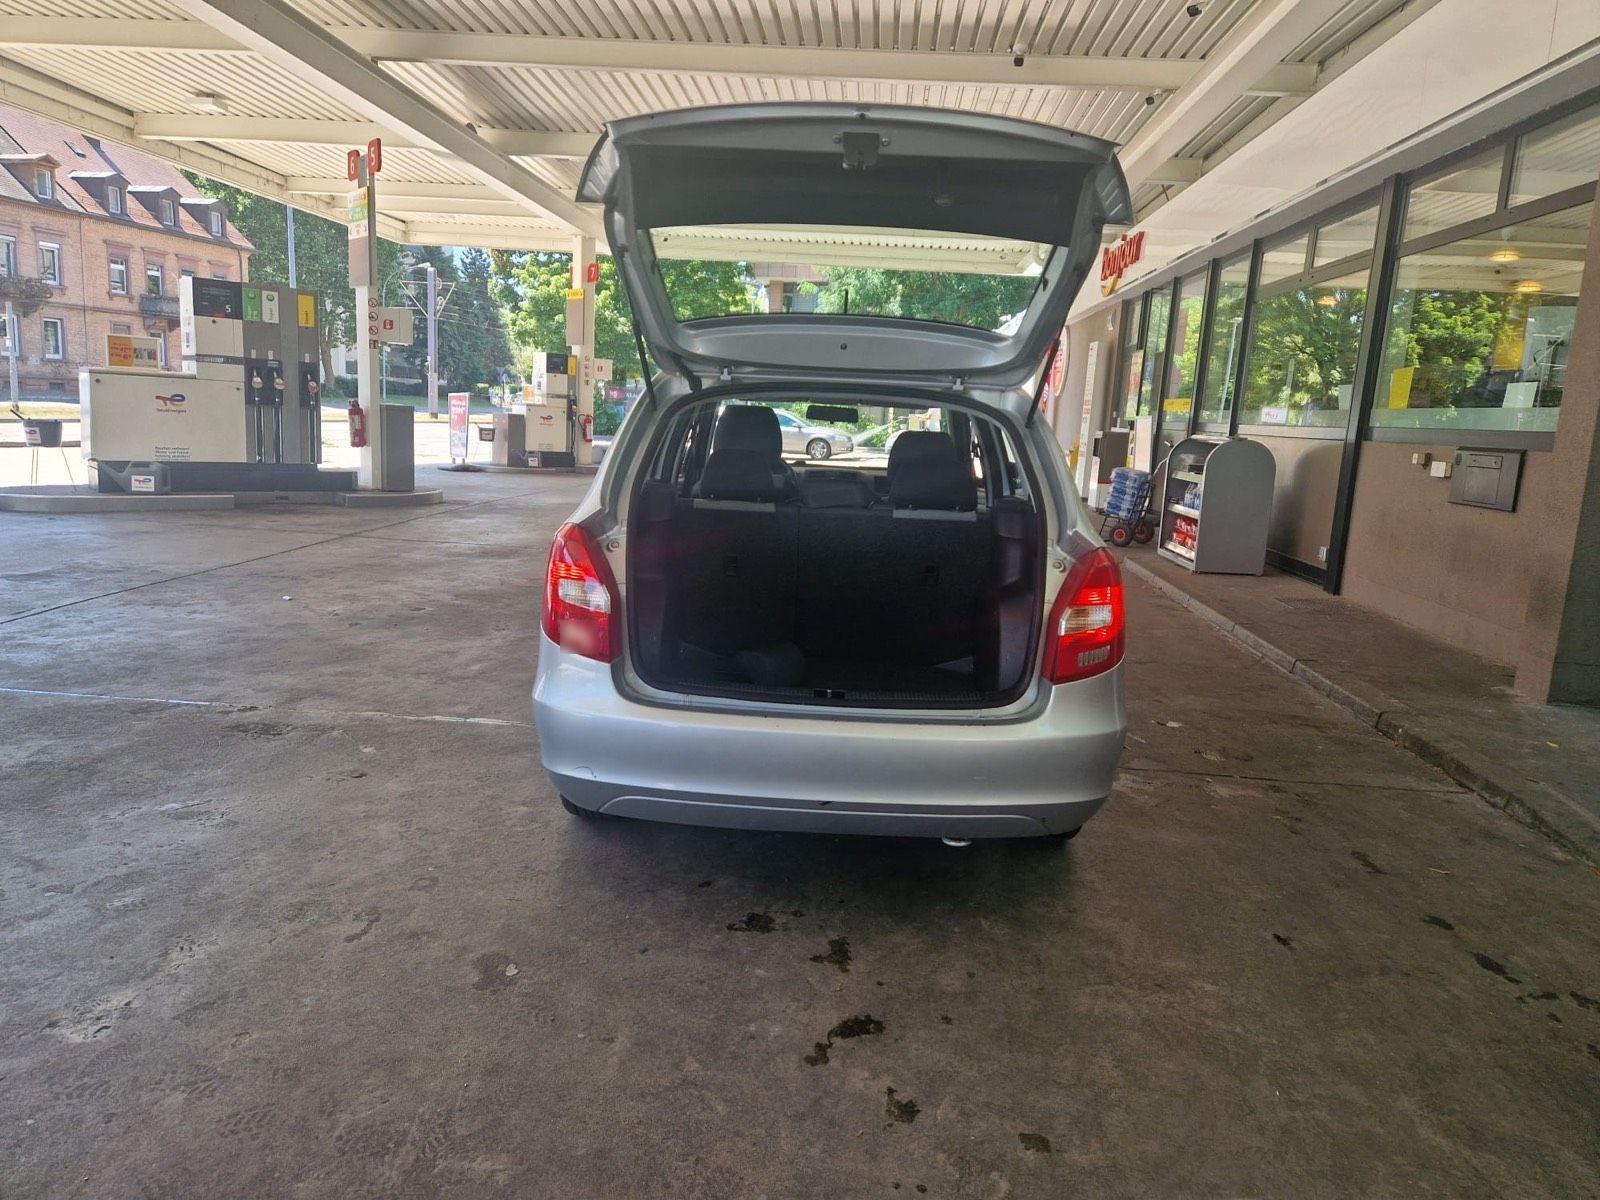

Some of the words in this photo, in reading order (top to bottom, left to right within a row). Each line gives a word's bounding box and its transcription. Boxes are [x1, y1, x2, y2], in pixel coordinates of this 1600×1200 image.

[350, 156, 355, 175] 6
[370, 146, 376, 167] 5
[1101, 231, 1145, 281] bonjour
[225, 304, 232, 313] 5
